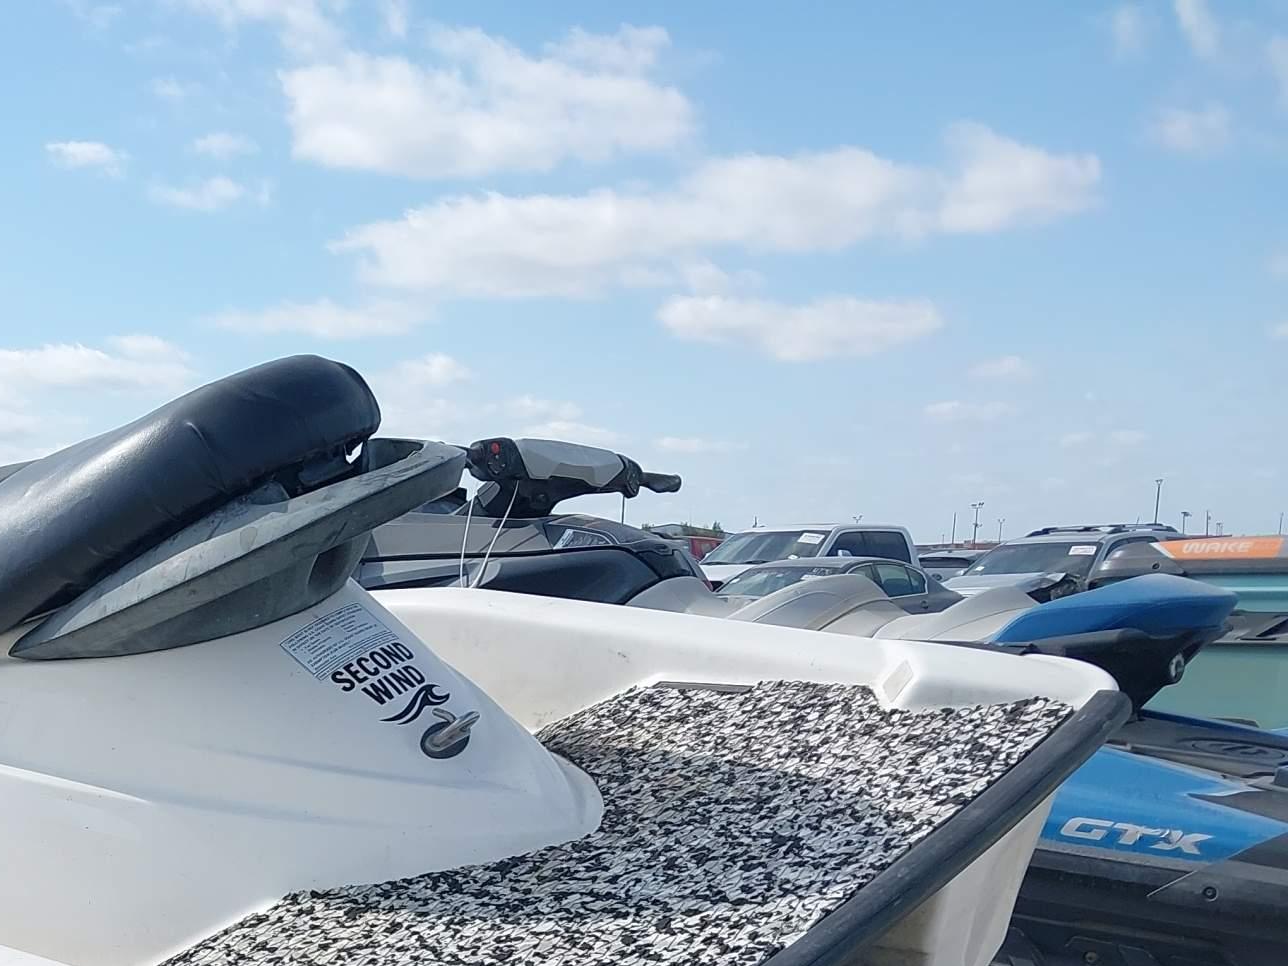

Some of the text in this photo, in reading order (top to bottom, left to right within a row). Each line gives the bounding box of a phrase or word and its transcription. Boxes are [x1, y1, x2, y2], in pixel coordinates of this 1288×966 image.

[1182, 541, 1253, 554] WAKE
[331, 642, 414, 692] SECOND
[361, 665, 426, 705] WIND
[1060, 816, 1214, 855] GTX
